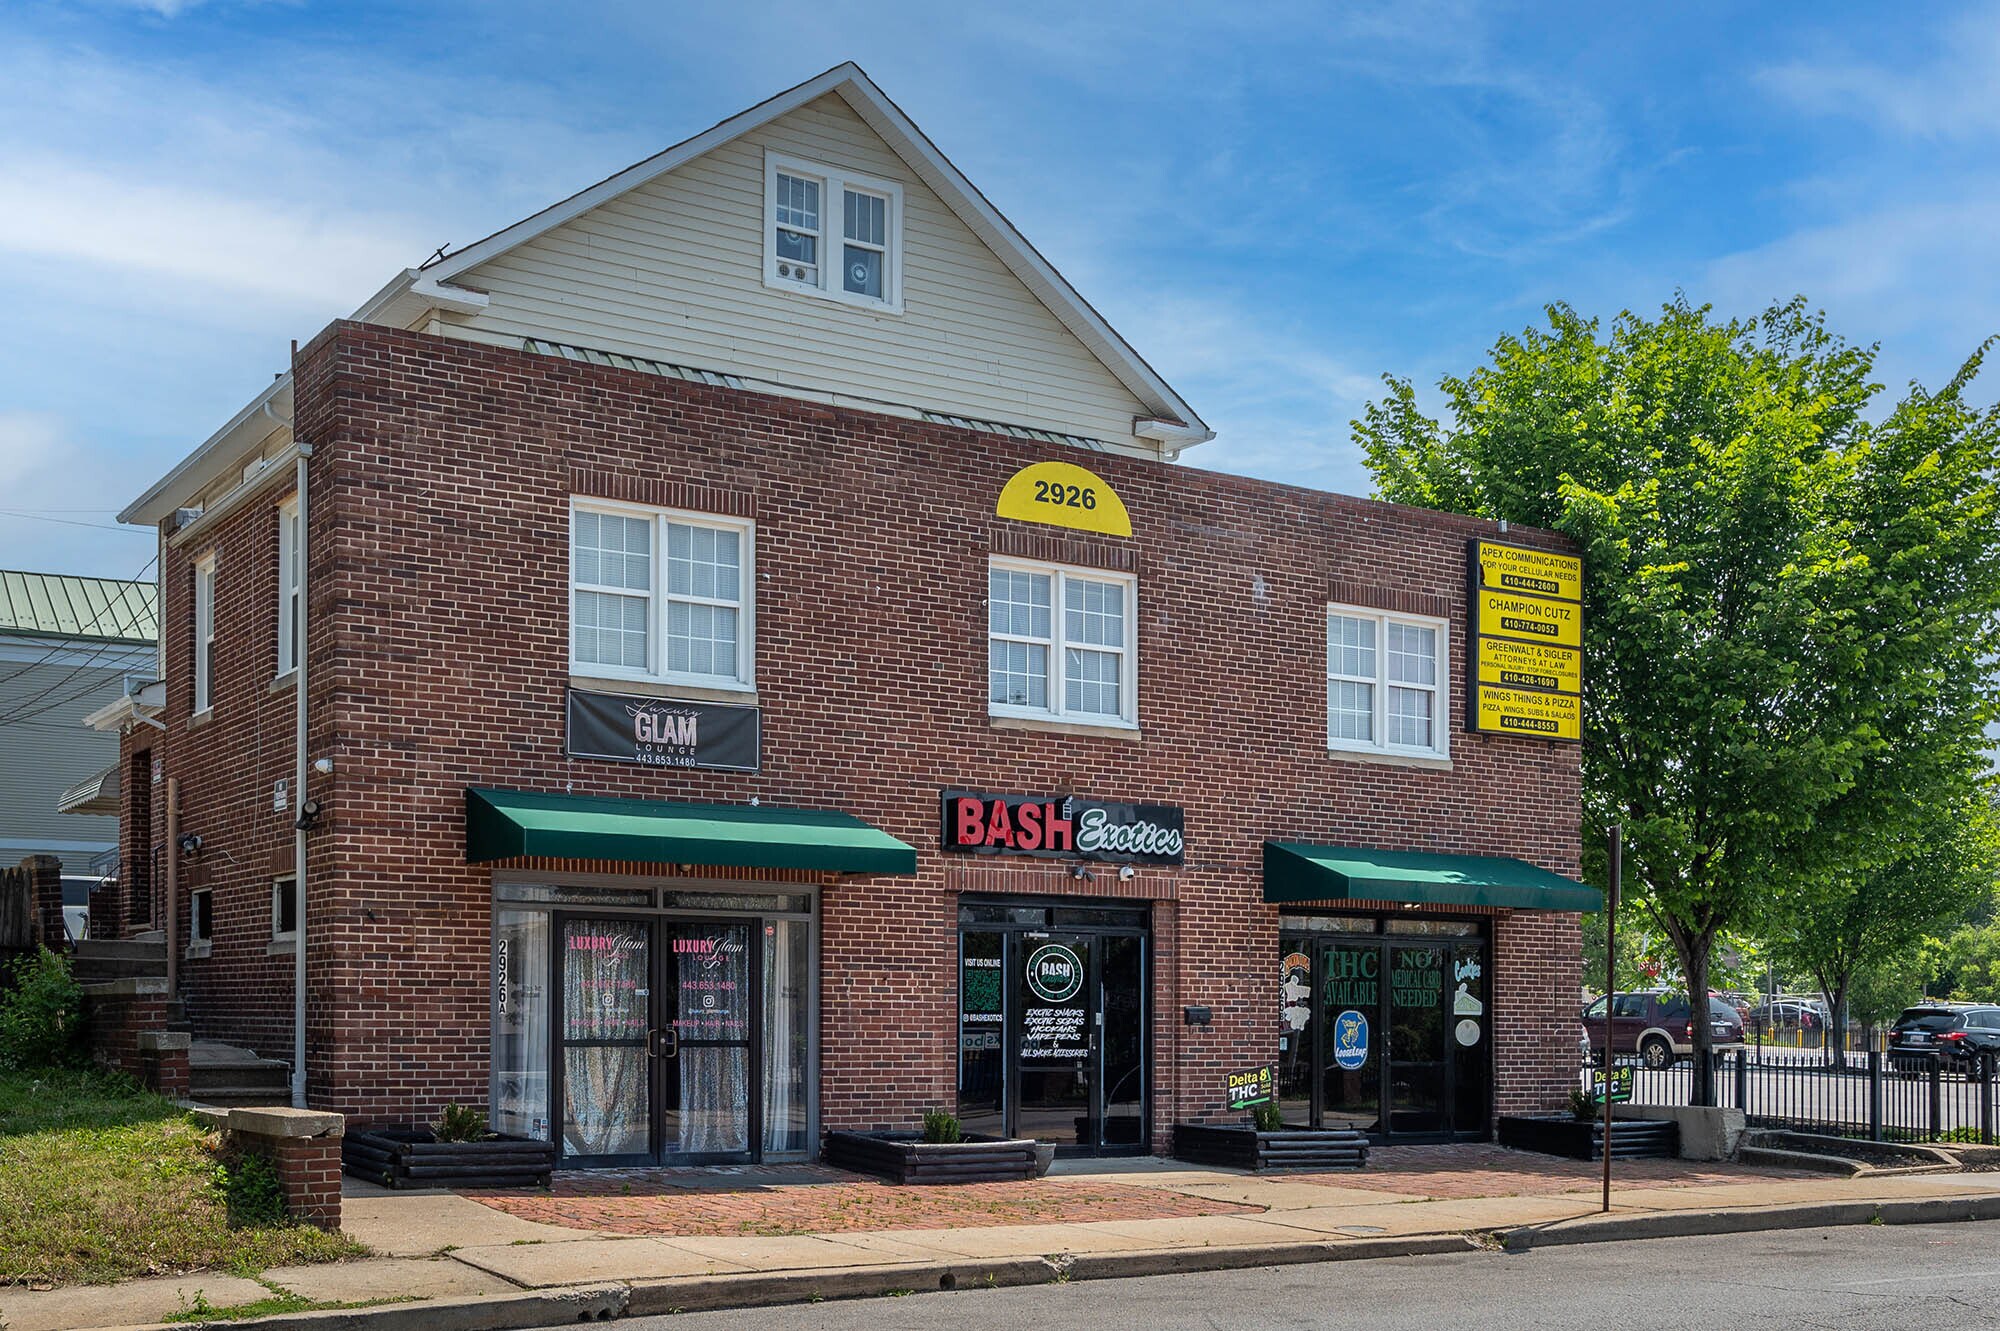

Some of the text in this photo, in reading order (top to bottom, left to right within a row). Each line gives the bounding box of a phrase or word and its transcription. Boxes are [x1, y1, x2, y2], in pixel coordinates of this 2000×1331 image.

[1034, 480, 1096, 510] 2926
[1482, 547, 1578, 571] APEX COMMUNICATIONS
[1482, 560, 1577, 581] FOR YOUR CELLULAR NEEDS
[1504, 576, 1556, 592] 410-444-2600
[1488, 598, 1571, 620] CHAMPION CUTZ
[1504, 619, 1555, 634] 410-774-0052
[1486, 641, 1573, 660] GREENWALT & SIGLER
[1480, 660, 1506, 669] PERSONAL
[1527, 665, 1539, 673] STOP
[1540, 668, 1578, 678] FORECLOSURES
[1493, 653, 1537, 666] ATTORNEYS
[1549, 661, 1566, 669] LAW
[1483, 690, 1575, 709] WINGS THINGS & PIZZA
[625, 698, 703, 724] Luxury
[1527, 708, 1544, 717] SUBS
[1545, 710, 1550, 718] &
[1550, 710, 1576, 720] SALADS
[634, 712, 697, 746] GLAM
[1503, 717, 1556, 731] 410-444-8555
[635, 743, 696, 756] LOUNGE
[636, 753, 696, 767] 443.653.1480
[957, 797, 1183, 856] BASH Exotics
[570, 932, 644, 967] LUXURY Glam
[673, 936, 744, 969] LUXURY Glam
[964, 958, 1001, 967] VISIT US ONLINE
[1324, 951, 1378, 978] THC
[1401, 950, 1432, 969] NO
[1041, 962, 1071, 977] BASH
[682, 981, 736, 990] 443.653.1480
[1391, 969, 1442, 989] MEDICAL CARD
[1324, 981, 1377, 1006] AVAILABLE
[1392, 989, 1438, 1007] NEEDED
[1024, 1017, 1085, 1026] EXOTIC SODAS
[1025, 1008, 1085, 1018] EXOTIC SNACKS
[672, 1019, 700, 1029] MAKEUP
[1030, 1025, 1077, 1034] HOOKAHS
[1020, 1048, 1089, 1058] ALL SMOKE ACCESSORIES
[1052, 1040, 1059, 1048] &
[1228, 1068, 1267, 1087] Delta 8
[1594, 1067, 1628, 1082] Deta 8
[1228, 1083, 1258, 1101] THC
